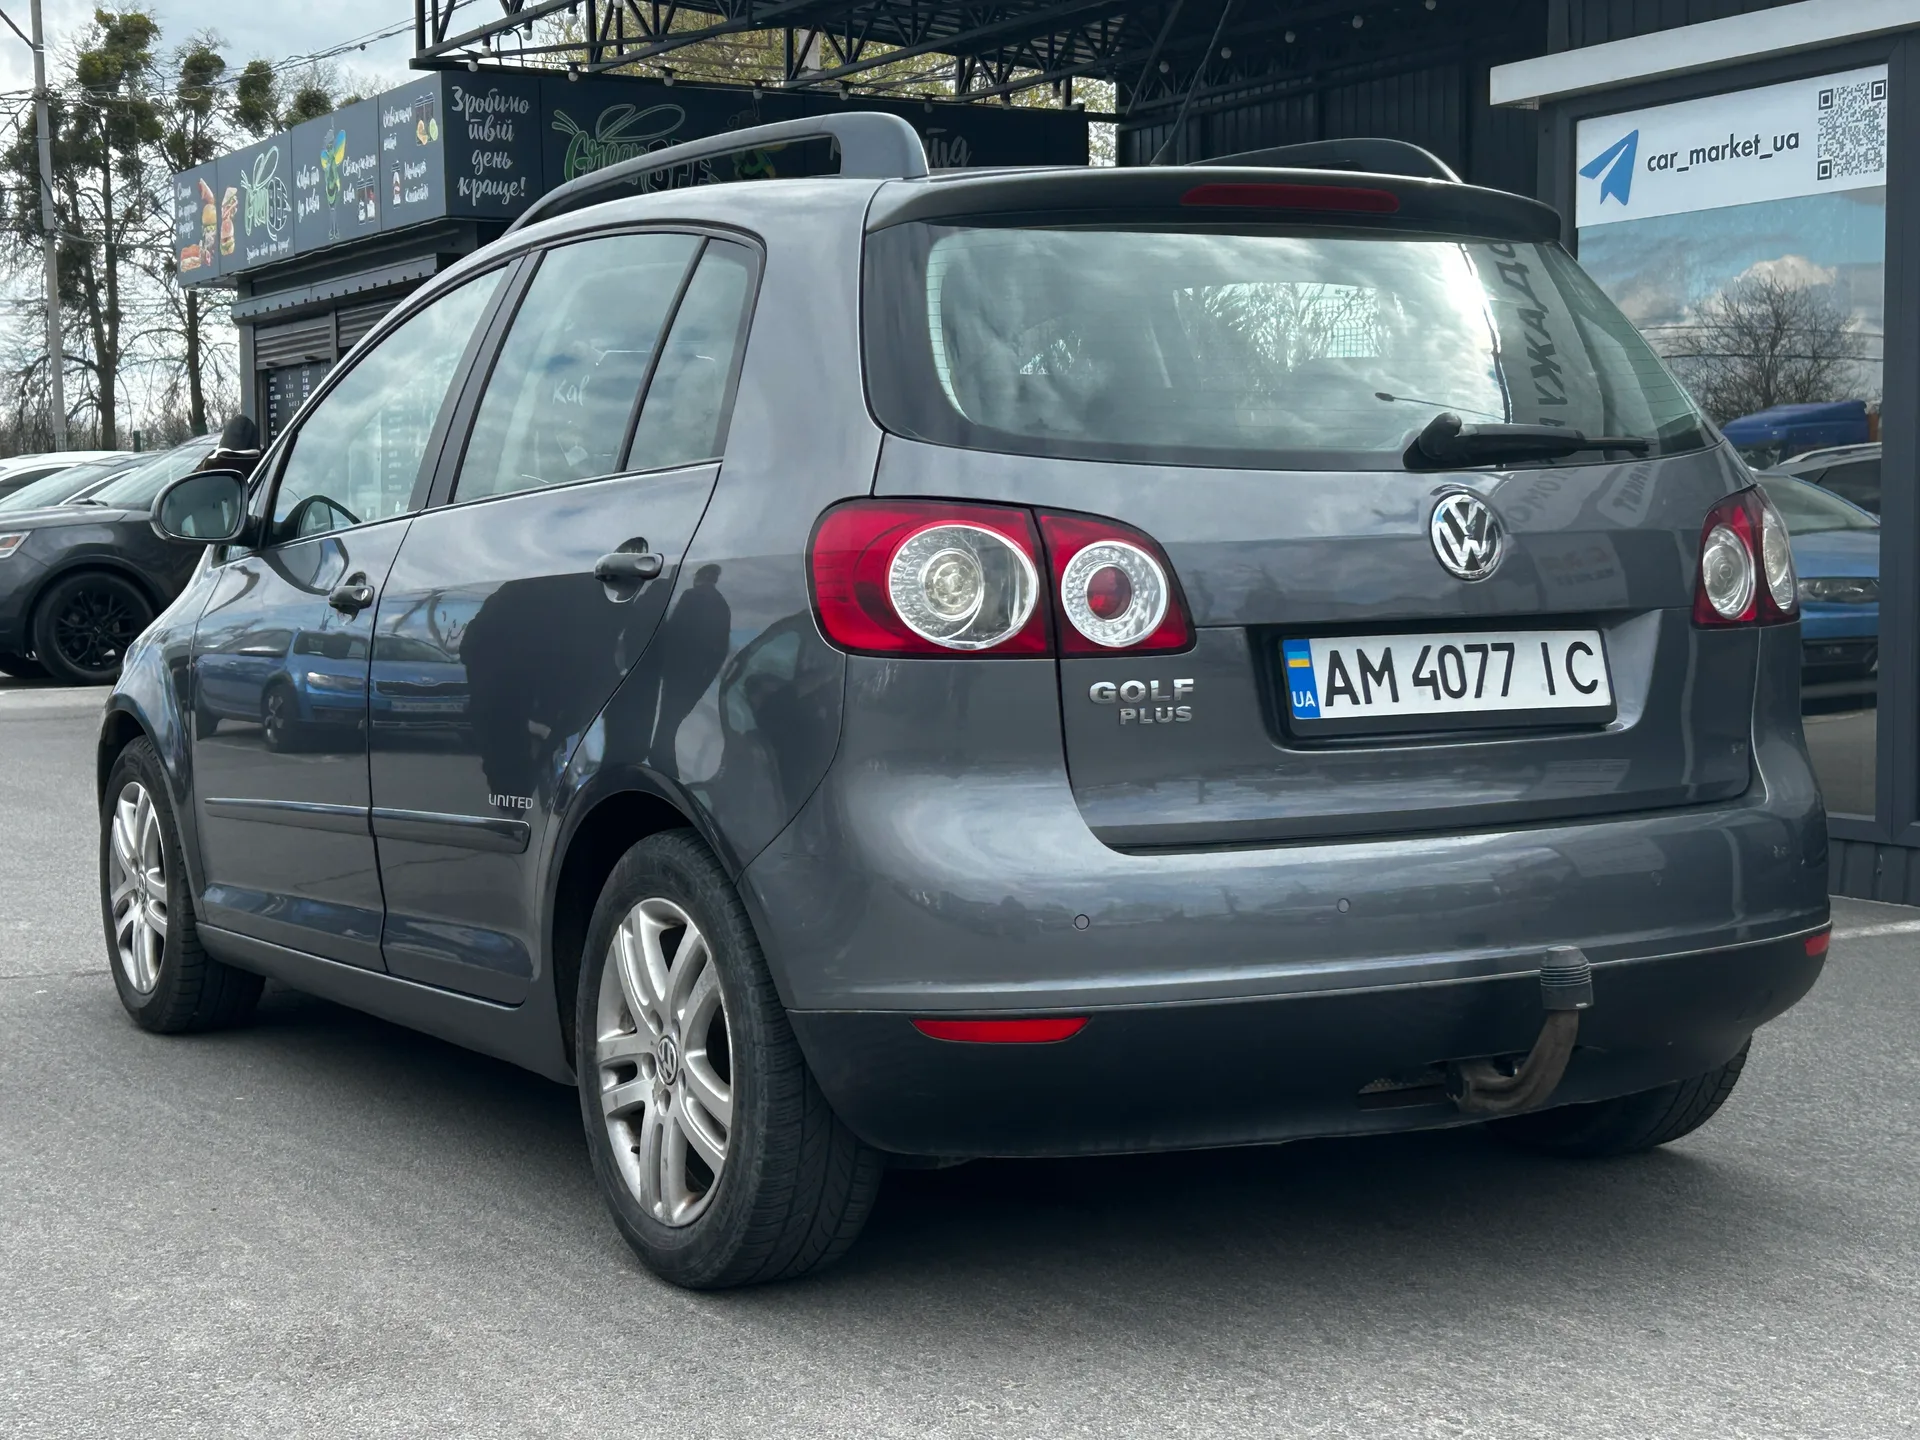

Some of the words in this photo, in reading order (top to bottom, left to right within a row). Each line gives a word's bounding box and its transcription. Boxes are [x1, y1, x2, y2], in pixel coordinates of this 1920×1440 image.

[451, 86, 529, 121] Зробимо
[468, 114, 514, 142] твій
[471, 149, 513, 175] день
[1647, 132, 1800, 173] car_market_ua
[457, 176, 526, 207] краще!
[1325, 647, 1400, 707] AM
[1412, 642, 1515, 701] 4077
[1541, 641, 1599, 696] IC
[1089, 678, 1195, 705] GOLF
[1292, 690, 1317, 708] UA
[1119, 705, 1193, 726] PLUS
[488, 793, 535, 810] UNITED
